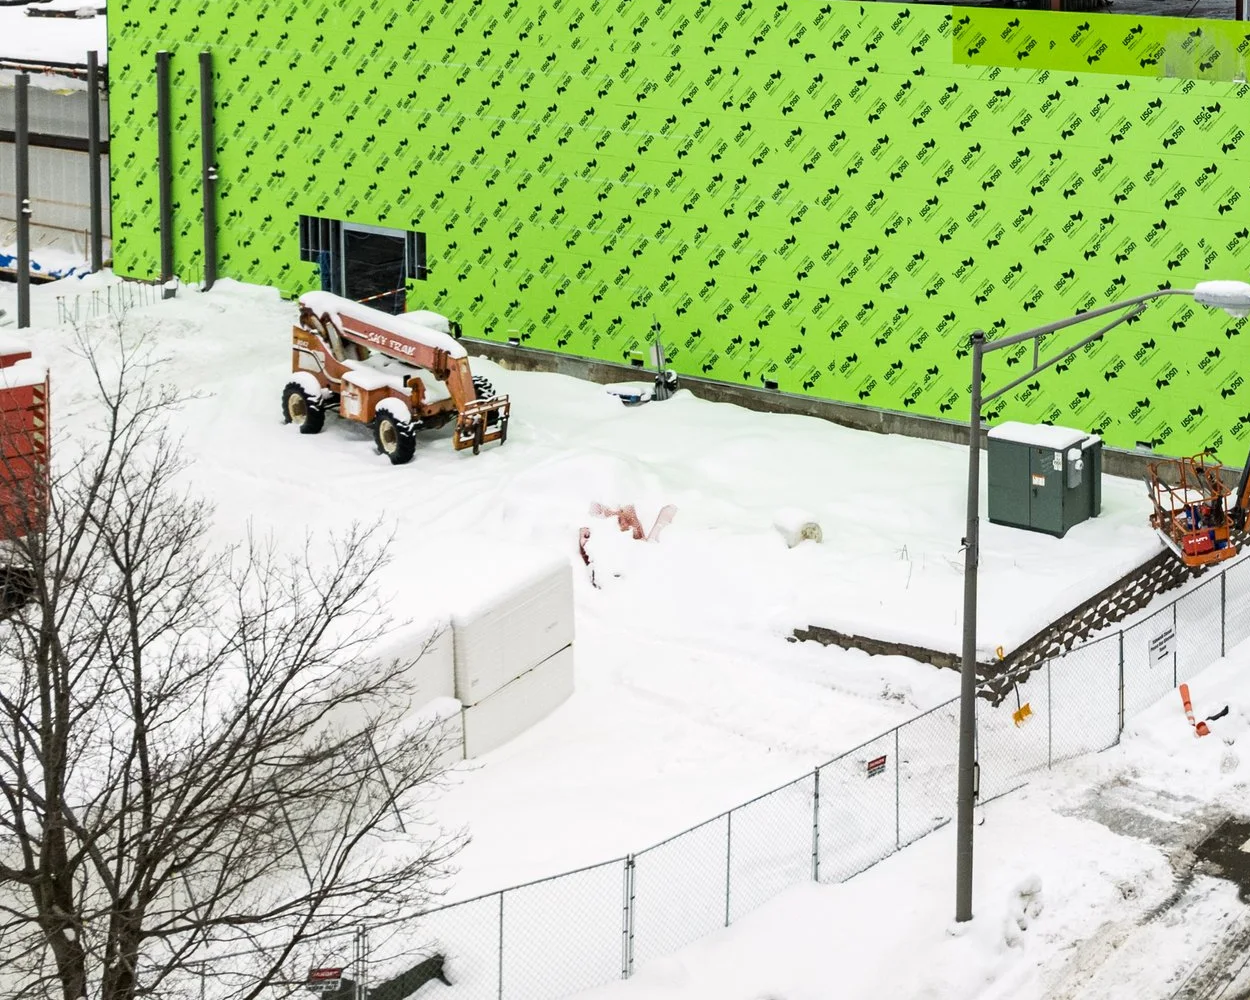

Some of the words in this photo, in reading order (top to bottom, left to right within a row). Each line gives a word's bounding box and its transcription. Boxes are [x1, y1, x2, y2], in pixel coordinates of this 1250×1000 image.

[680, 19, 689, 30] USG
[813, 13, 824, 26] USG
[719, 22, 728, 33] USG
[796, 26, 807, 38] USG
[937, 21, 949, 33] USG
[1001, 27, 1012, 39] USG
[840, 29, 851, 41] USG
[919, 34, 930, 46] USG
[1070, 31, 1081, 43] USG
[1122, 33, 1134, 46] USG
[976, 37, 987, 48] USG
[1025, 40, 1037, 52] USG
[1236, 40, 1249, 53] USG
[1096, 44, 1107, 56] USG
[1154, 47, 1166, 59] USG
[1209, 51, 1221, 63] USG
[989, 68, 1001, 80] USG
[1039, 71, 1049, 83] USG
[764, 79, 774, 91] USG
[1183, 81, 1195, 94] USG
[1237, 84, 1250, 98] USG
[689, 86, 699, 98] USG
[747, 91, 757, 103] USG
[894, 89, 905, 102] USG
[790, 95, 800, 107] USG
[832, 98, 842, 110] USG
[939, 92, 950, 105] USG
[986, 96, 998, 109] USG
[876, 102, 887, 114] USG
[921, 105, 932, 118] USG
[1040, 100, 1052, 113] USG
[968, 109, 979, 122] USG
[1020, 114, 1032, 126] USG
[1140, 108, 1153, 121] USG
[1070, 117, 1082, 130] USG
[1120, 121, 1132, 134] USG
[694, 127, 703, 138] USG
[734, 131, 744, 142] USG
[1172, 125, 1185, 139] USG
[1231, 130, 1245, 144] USG
[784, 136, 795, 147] USG
[760, 147, 769, 159] USG
[871, 144, 881, 156] USG
[916, 148, 927, 160] USG
[811, 152, 821, 164] USG
[961, 152, 973, 164] USG
[1009, 156, 1021, 169] USG
[898, 160, 909, 172] USG
[1092, 164, 1104, 177] USG
[990, 169, 1002, 182] USG
[1039, 174, 1051, 187] USG
[1195, 173, 1208, 187] USG
[666, 176, 676, 188] USG
[1072, 177, 1084, 190] USG
[1123, 182, 1135, 195] USG
[1174, 187, 1186, 200] USG
[1228, 192, 1241, 205] USG
[755, 200, 765, 212] USG
[865, 199, 876, 211] USG
[919, 205, 930, 217] USG
[893, 216, 903, 228] USG
[966, 210, 978, 222] USG
[1013, 215, 1024, 227] USG
[948, 222, 959, 235] USG
[1062, 220, 1074, 233] USG
[1043, 233, 1054, 245] USG
[1145, 229, 1157, 242] USG
[778, 244, 788, 255] USG
[1124, 242, 1136, 255] USG
[1226, 238, 1239, 251] USG
[716, 249, 725, 260] USG
[822, 249, 832, 261] USG
[1177, 248, 1189, 261] USG
[804, 261, 815, 272] USG
[906, 260, 917, 272] USG
[848, 267, 858, 278] USG
[888, 272, 899, 284] USG
[1002, 272, 1014, 284] USG
[934, 278, 945, 290] USG
[983, 284, 995, 296] USG
[1054, 278, 1066, 291] USG
[699, 286, 709, 297] USG
[1032, 290, 1044, 302] USG
[1104, 284, 1117, 297] USG
[683, 297, 693, 308] USG
[724, 304, 734, 315] USG
[765, 310, 775, 321] USG
[1181, 309, 1194, 322] USG
[838, 320, 849, 332] USG
[936, 320, 947, 332] USG
[883, 327, 893, 339] USG
[918, 332, 929, 344] USG
[366, 332, 387, 346] SKY
[389, 339, 416, 356] TRAK
[1015, 346, 1027, 358] USG
[1134, 348, 1146, 360] USG
[1113, 360, 1126, 372] USG
[1198, 357, 1211, 369] USG
[1165, 368, 1178, 380] USG
[1231, 377, 1244, 390] USG
[912, 387, 922, 399] USG
[948, 393, 959, 405] USG
[1020, 390, 1031, 402] USG
[995, 400, 1007, 412] USG
[1069, 397, 1081, 409] USG
[1129, 407, 1141, 419] USG
[1100, 417, 1112, 429] USG
[1181, 414, 1194, 427] USG
[1160, 427, 1173, 439] USG
[1230, 422, 1243, 435] USG
